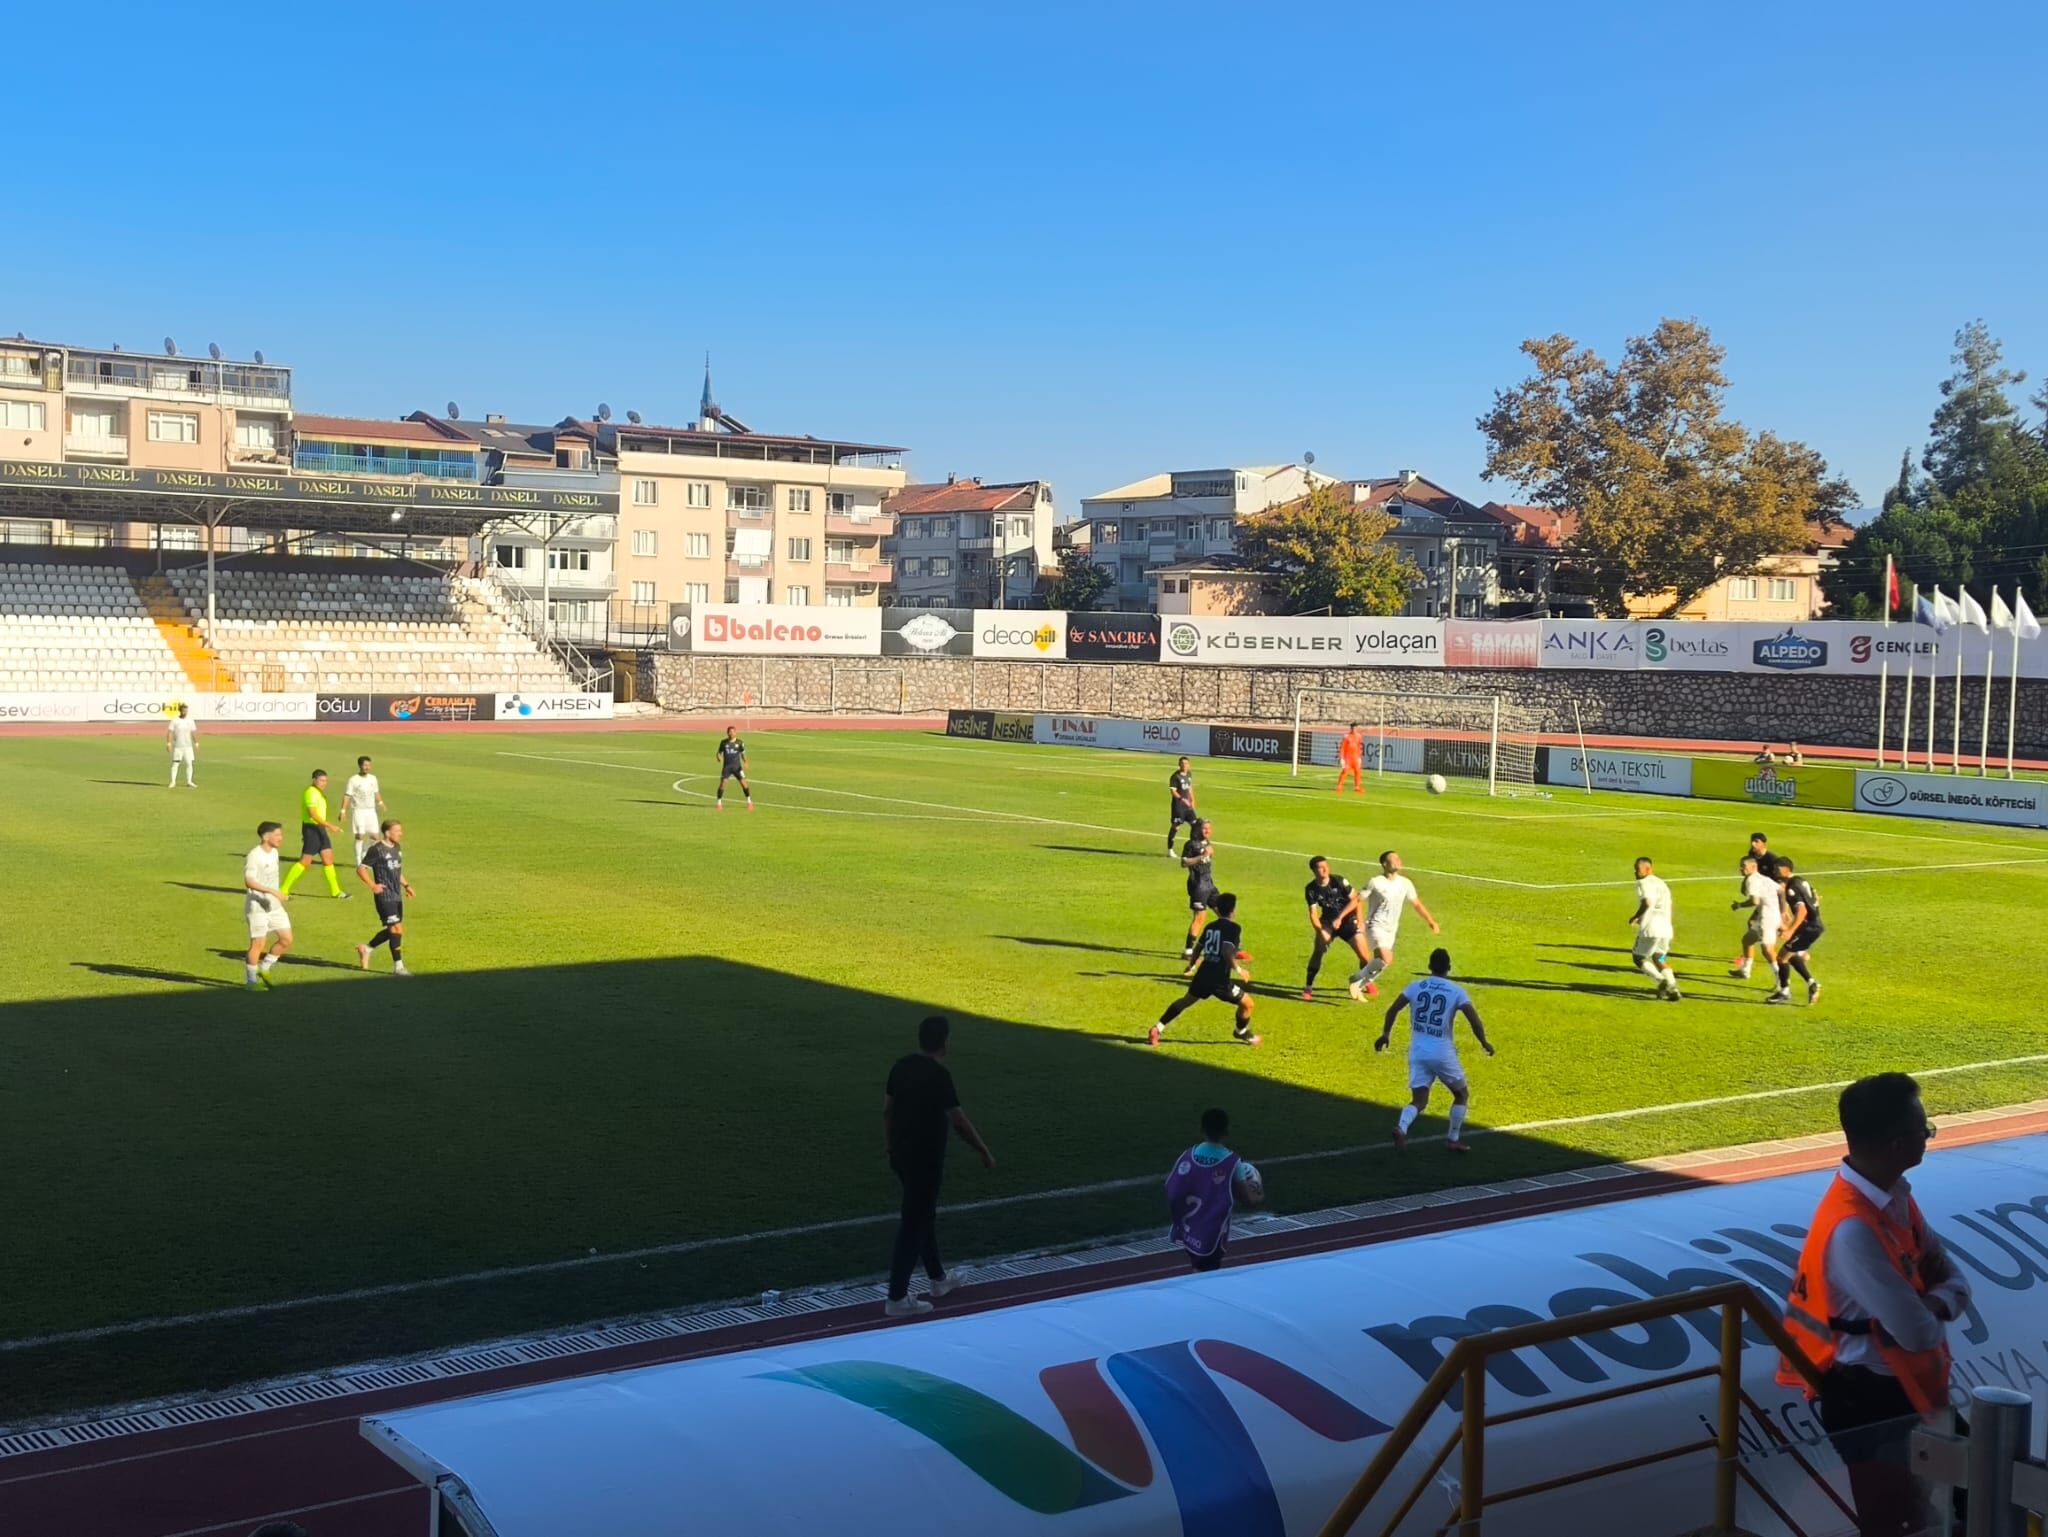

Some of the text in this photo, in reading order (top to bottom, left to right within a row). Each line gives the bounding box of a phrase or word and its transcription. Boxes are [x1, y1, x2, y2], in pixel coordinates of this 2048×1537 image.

[4, 463, 68, 479] DASELL
[78, 466, 140, 482] DASELL
[156, 472, 216, 488] DASELL
[226, 476, 284, 491] DASELL
[299, 481, 355, 494] DASELL
[363, 484, 417, 497] DASELL
[431, 487, 483, 501] DASELL
[491, 490, 541, 503] DASELL
[553, 493, 602, 506] DASELL
[730, 619, 822, 641] baleno
[983, 624, 1056, 645] decohill
[1088, 630, 1157, 645] SANCREA
[1207, 633, 1344, 650] KÖSENLER
[1356, 630, 1437, 654] yolaçan
[1544, 631, 1633, 659] ANKA
[1760, 645, 1821, 659] ALPEDO
[537, 699, 602, 711] AHSEN
[1232, 732, 1279, 755] İKUDER
[1621, 760, 1667, 779] TEKSTİL
[1910, 790, 2037, 810] GÜRSEL İNEGÖL KÖFTECİSİ
[1415, 991, 1447, 1026] 22
[1182, 1195, 1202, 1232] 2
